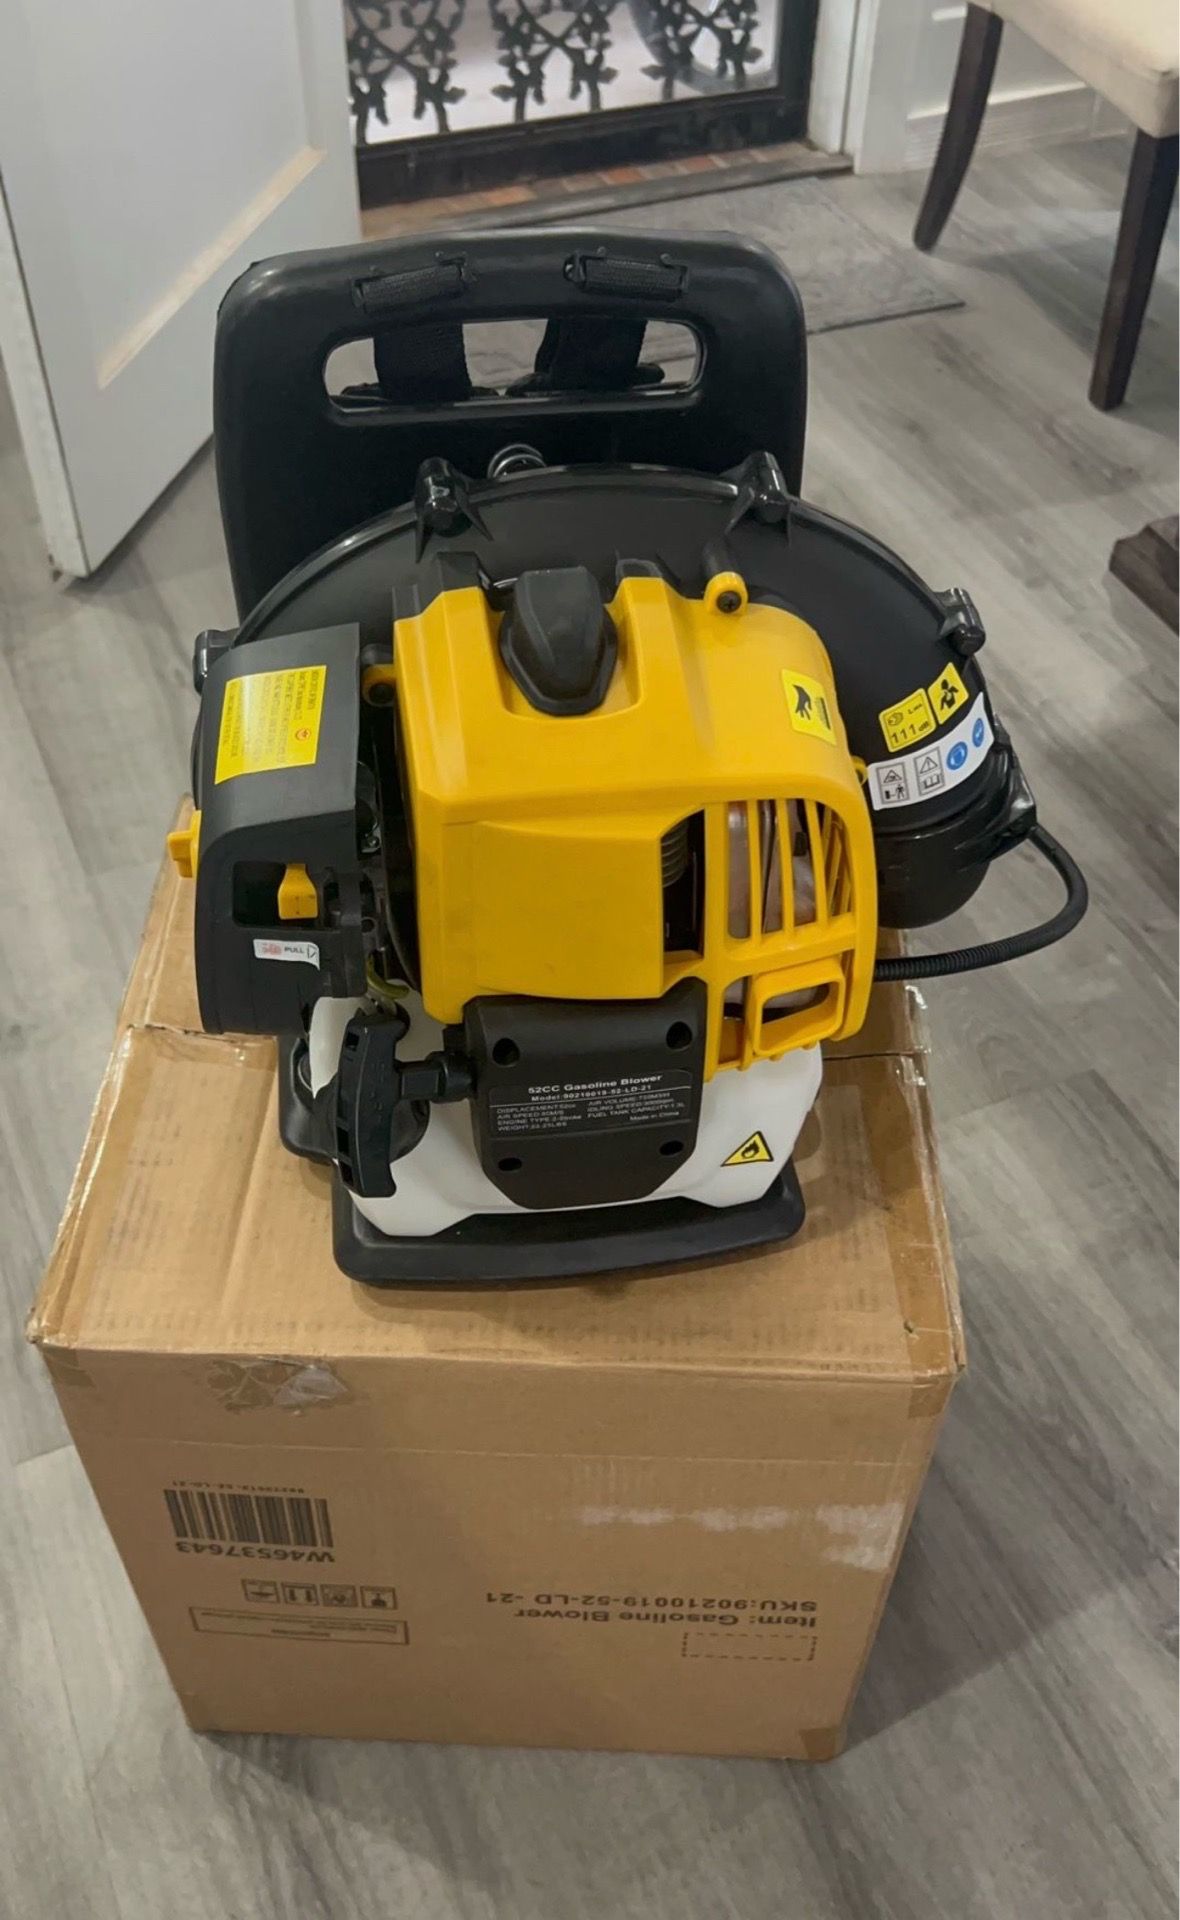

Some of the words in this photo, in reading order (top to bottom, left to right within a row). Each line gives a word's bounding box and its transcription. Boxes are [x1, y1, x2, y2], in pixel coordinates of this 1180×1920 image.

[528, 1085, 561, 1095] 52CC
[563, 1080, 618, 1092] Gasoline
[620, 1074, 663, 1086] Blower
[174, 1541, 336, 1564] W46537643
[513, 1608, 610, 1623] Blower
[618, 1611, 739, 1627] Gasoline
[747, 1615, 817, 1628] Item:
